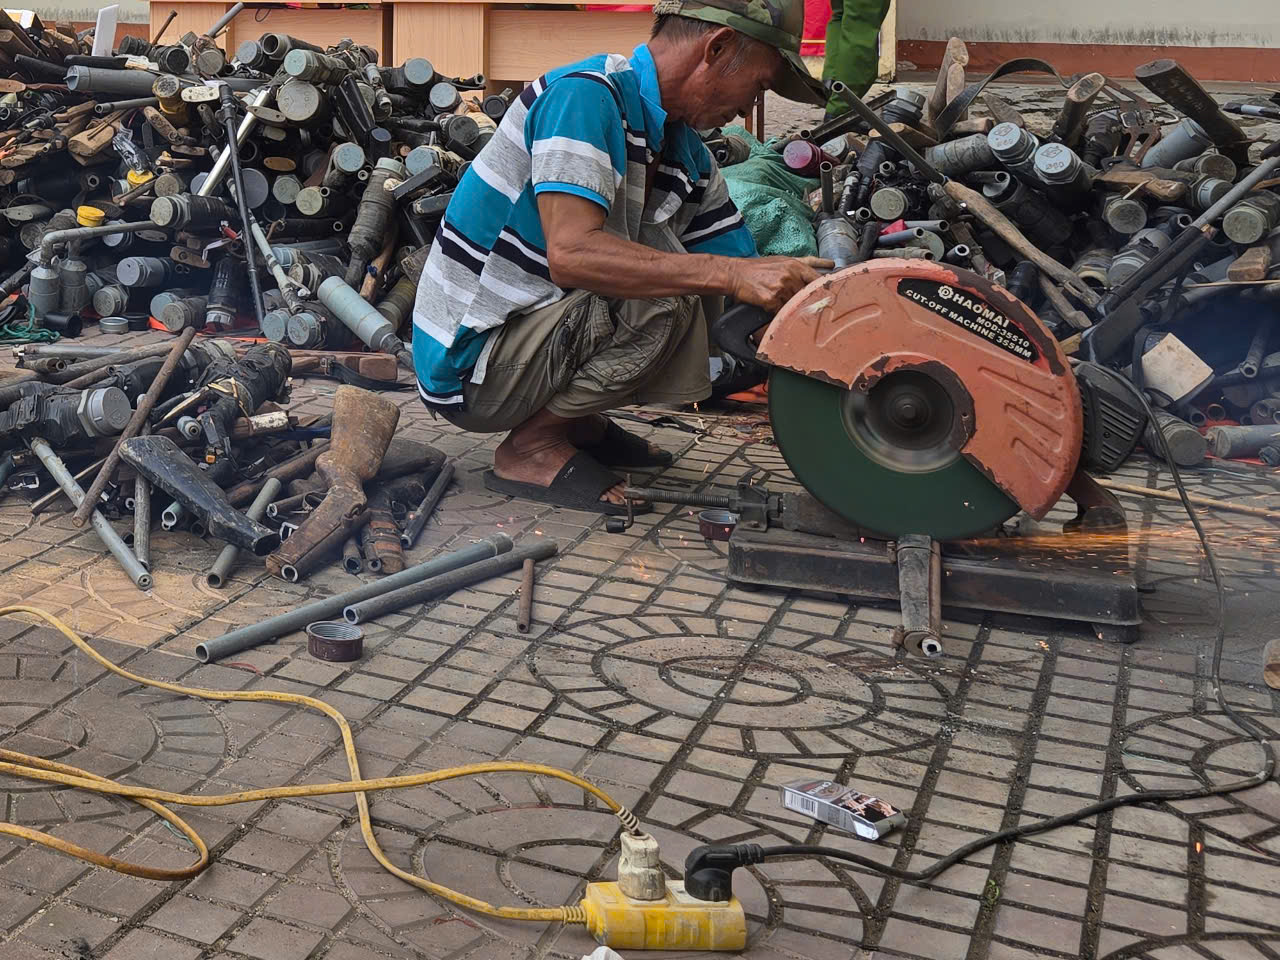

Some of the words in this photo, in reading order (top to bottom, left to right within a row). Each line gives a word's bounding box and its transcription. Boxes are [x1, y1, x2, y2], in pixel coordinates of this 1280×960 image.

[952, 293, 1010, 328] HAOMAI
[948, 311, 995, 340] MACHINE
[996, 334, 1032, 358] 355MM
